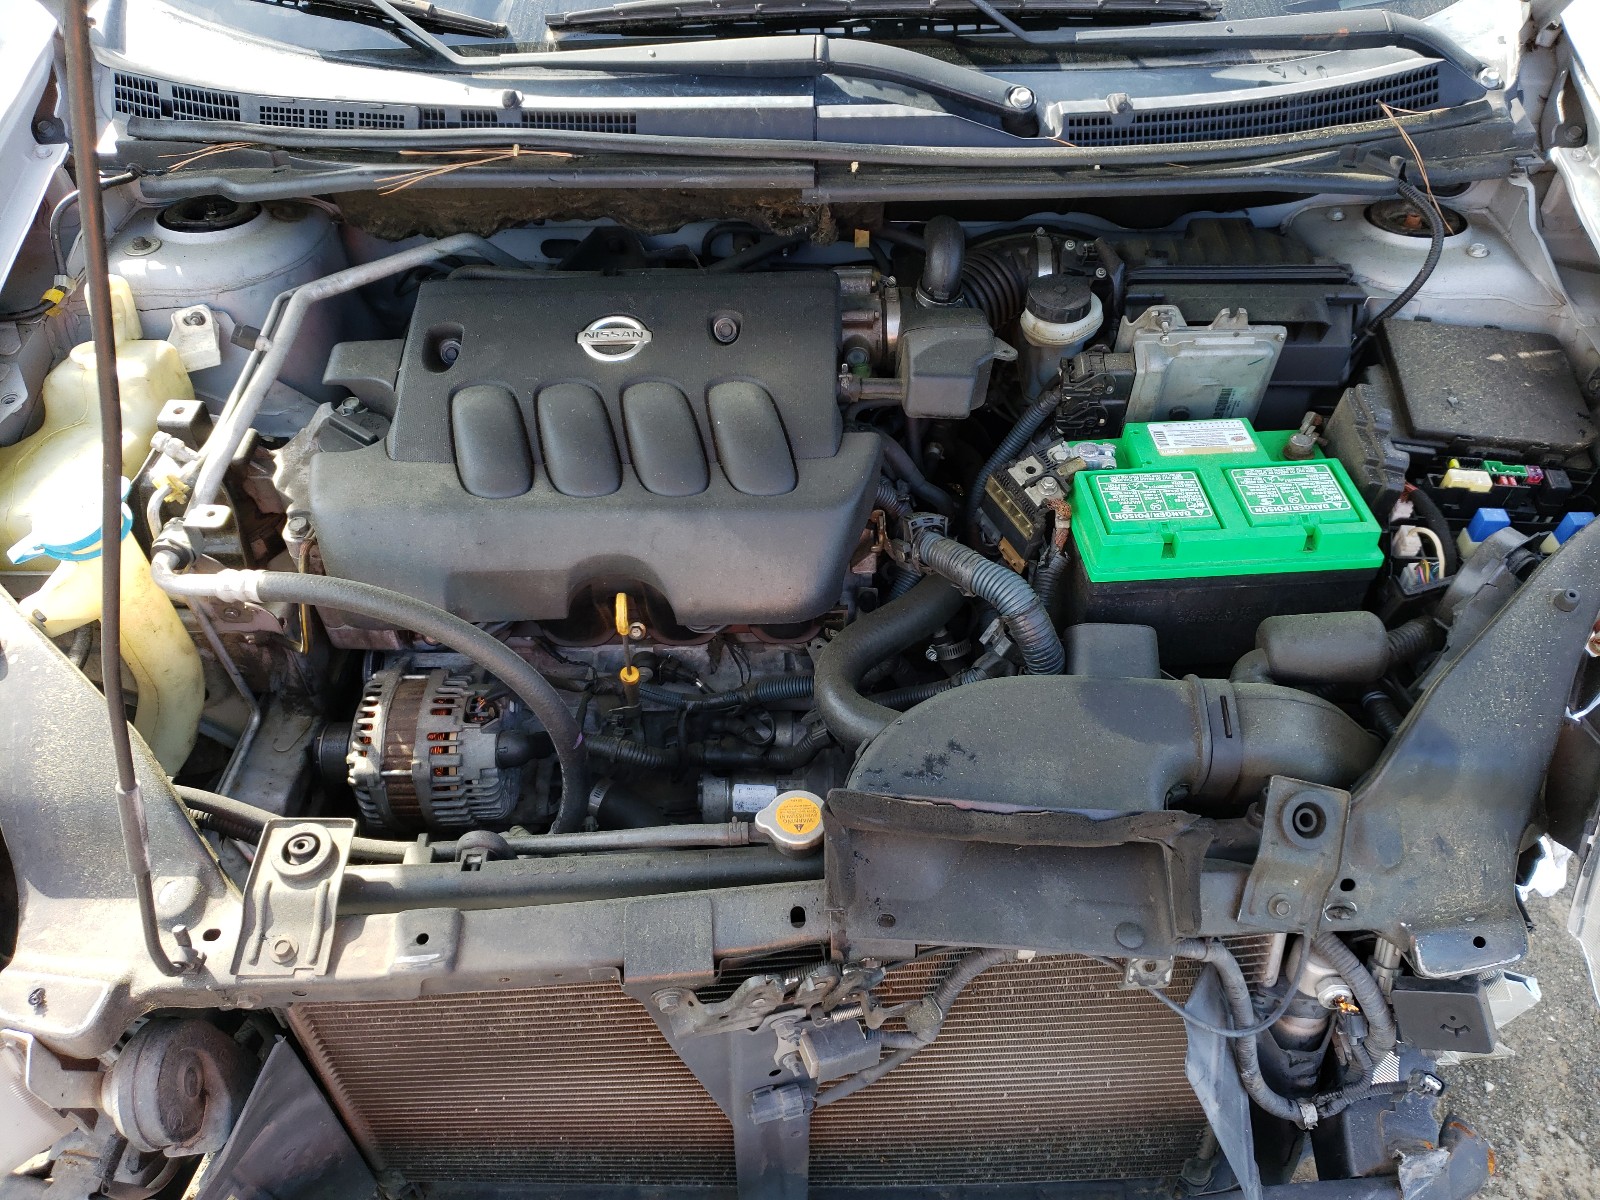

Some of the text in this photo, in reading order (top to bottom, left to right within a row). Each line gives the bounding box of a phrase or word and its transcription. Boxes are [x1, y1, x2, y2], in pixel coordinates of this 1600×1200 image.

[583, 331, 644, 339] NISSAN
[1254, 503, 1330, 513] DANGER/POISON
[1114, 510, 1191, 520] DANGER/POISON
